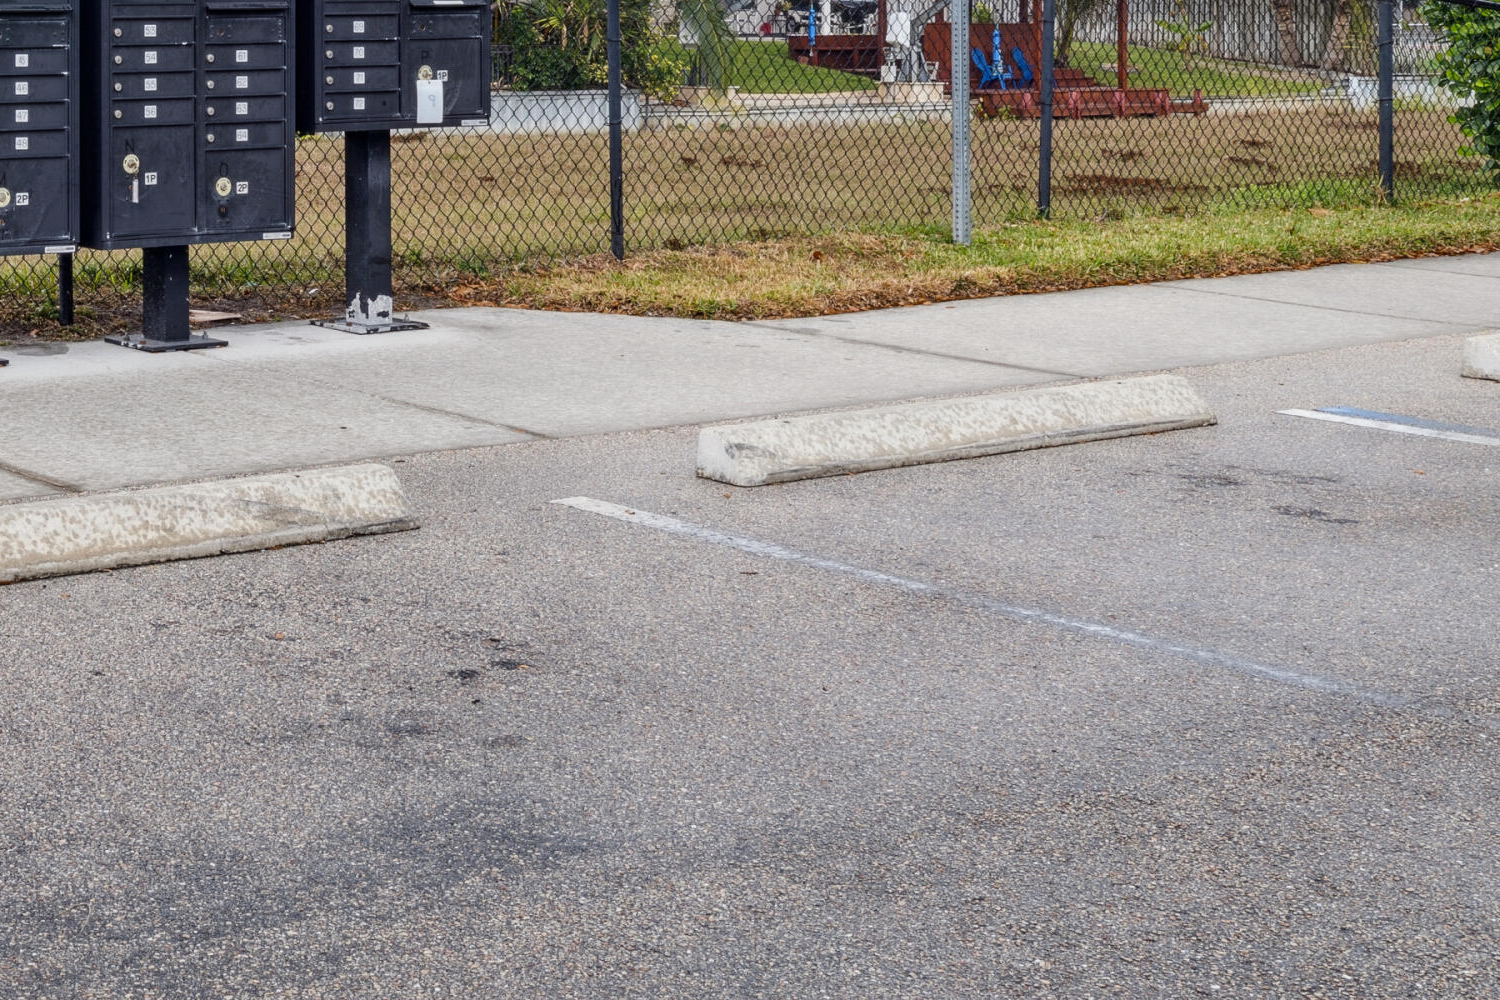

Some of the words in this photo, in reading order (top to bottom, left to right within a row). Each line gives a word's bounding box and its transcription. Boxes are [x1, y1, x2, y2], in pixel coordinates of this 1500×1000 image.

[438, 72, 447, 80] 1P
[146, 174, 156, 183] 1P
[237, 184, 247, 192] 2P
[17, 195, 27, 203] 2P
